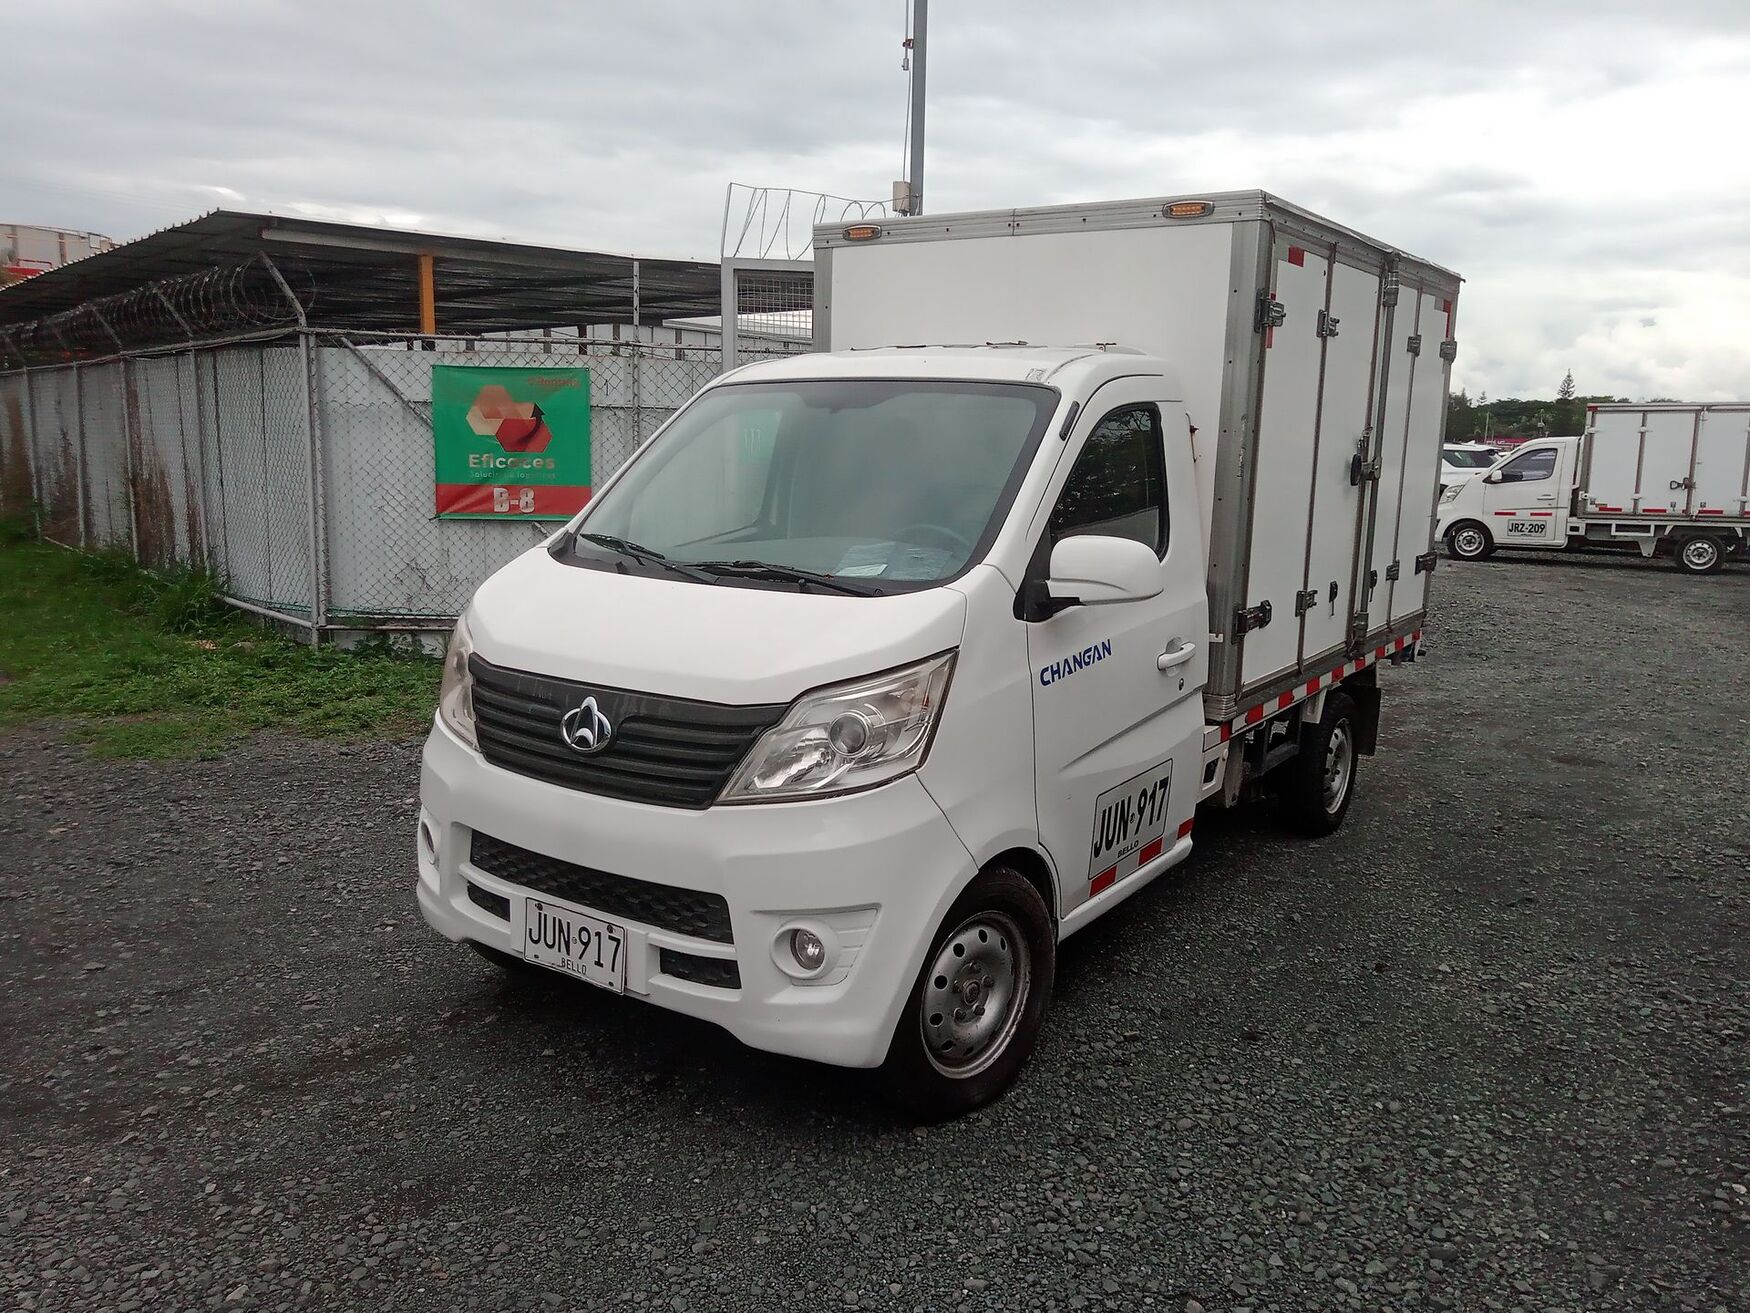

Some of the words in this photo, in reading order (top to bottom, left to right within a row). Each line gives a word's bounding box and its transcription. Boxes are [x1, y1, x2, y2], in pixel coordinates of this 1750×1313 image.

[1508, 522, 1546, 534] JRZ-209
[1040, 639, 1112, 686] CHANGAN
[1117, 840, 1139, 858] BELLO
[561, 957, 586, 975] BELLO
